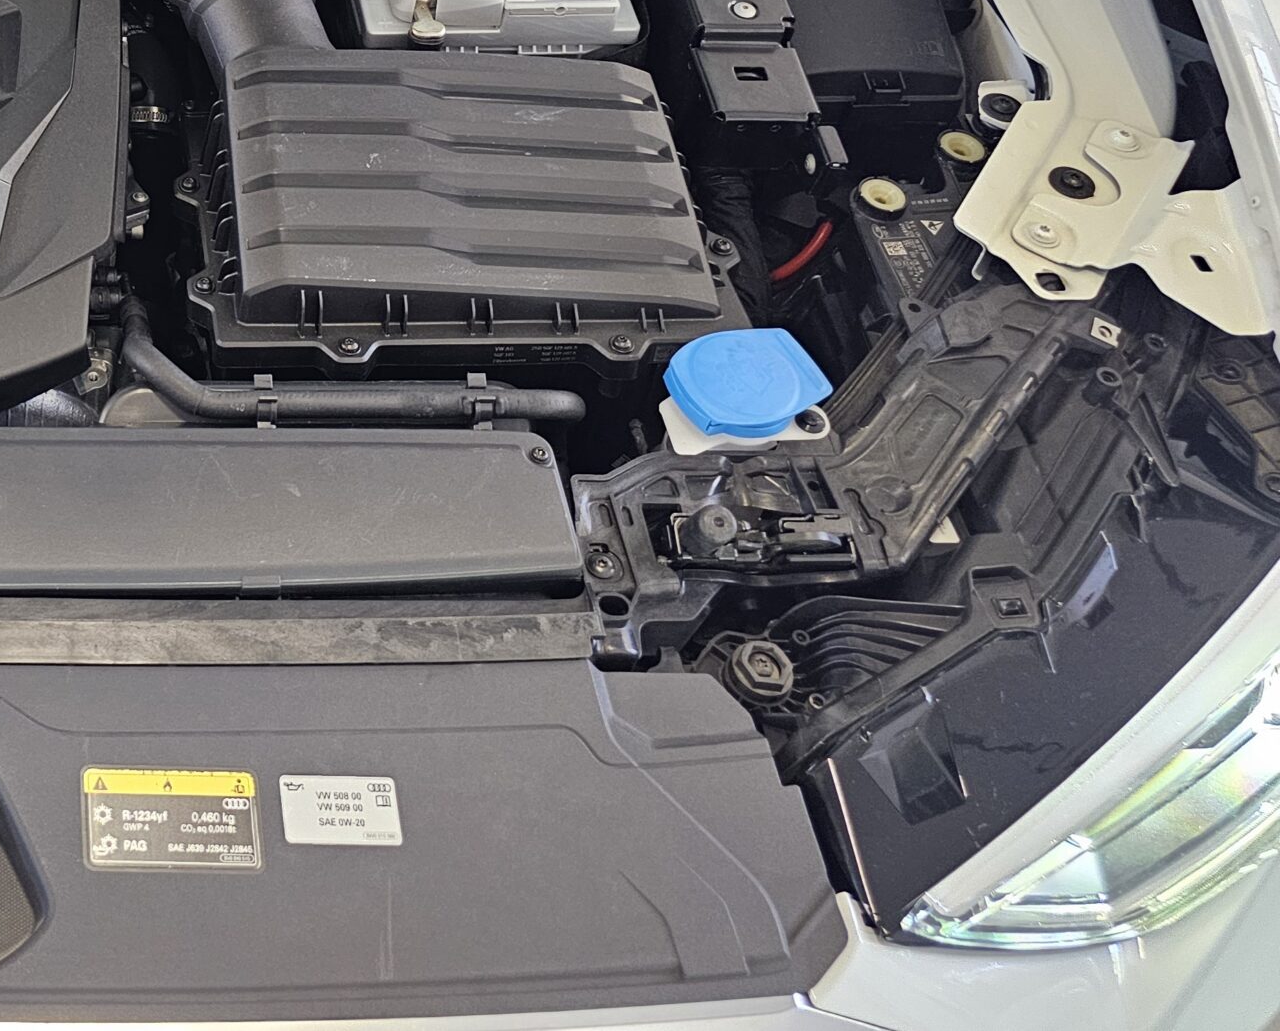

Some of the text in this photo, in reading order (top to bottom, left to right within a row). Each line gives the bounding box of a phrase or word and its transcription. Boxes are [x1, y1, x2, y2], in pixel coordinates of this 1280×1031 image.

[315, 791, 362, 800] VW 508 00
[317, 803, 363, 812] VW 509 00
[122, 810, 168, 823] R-1234yf
[222, 812, 235, 825] kg
[318, 818, 365, 827] SAE 0W-20
[123, 840, 148, 851] PAG
[168, 843, 185, 852] SAE
